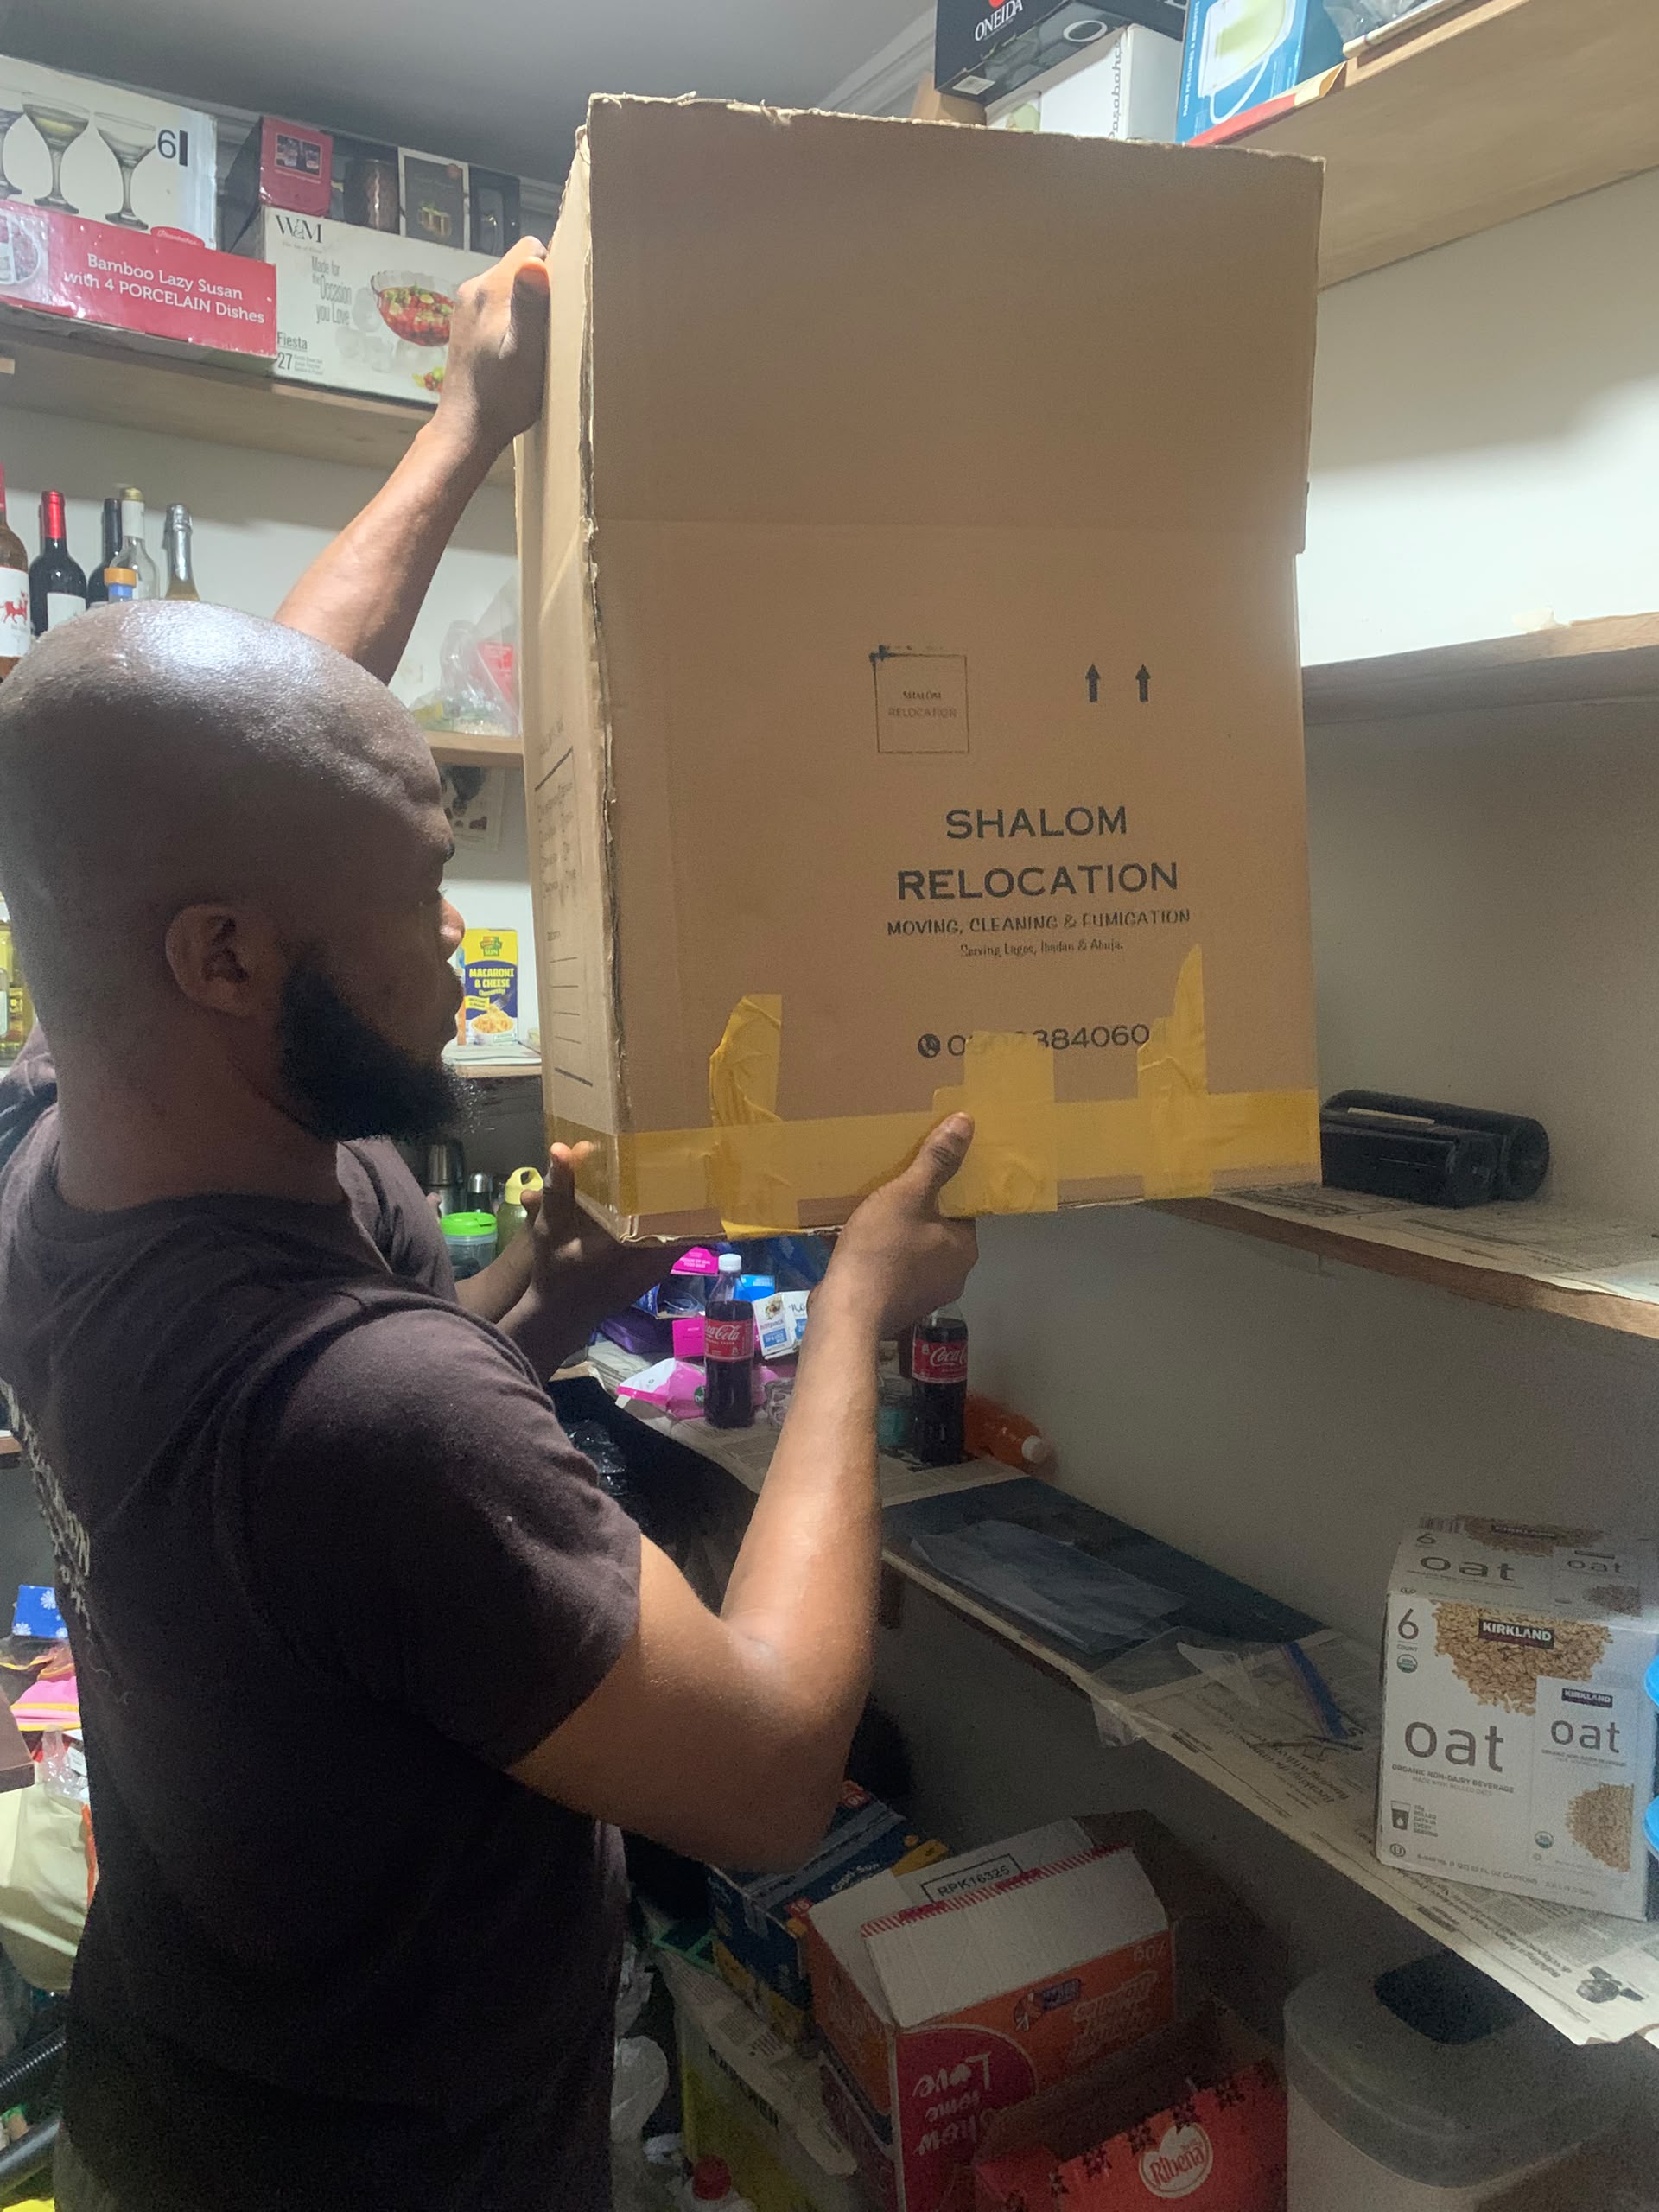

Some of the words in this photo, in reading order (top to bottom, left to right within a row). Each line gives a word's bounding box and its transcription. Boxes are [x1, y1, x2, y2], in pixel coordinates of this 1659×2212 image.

[975, 0, 1023, 41] ONEIDA
[1185, 49, 1196, 91] FEATURES
[1192, 1, 1201, 42] BENEFITS
[87, 253, 155, 281] Bamboo
[158, 270, 194, 291] Lazy
[198, 279, 243, 300] Susan
[311, 256, 330, 275] Made
[331, 260, 340, 276] for
[63, 271, 99, 289] with
[105, 278, 114, 291] 4
[118, 281, 211, 313] PORCELAIN
[215, 302, 264, 324] Dishes
[320, 275, 353, 304] Occasion
[316, 304, 331, 325] you
[332, 302, 350, 325] Love
[277, 332, 308, 350] Fiesta
[277, 352, 293, 371] 27
[945, 805, 1127, 840] SHALOM
[897, 862, 1178, 900] RELOCATION
[887, 918, 963, 936] MOVING,
[969, 915, 1058, 933] CLEANING
[1064, 914, 1077, 929] &
[1083, 909, 1191, 928] FUMIGATION
[960, 944, 1002, 958] Serving
[1077, 939, 1088, 950] &
[469, 968, 515, 978] MACARONI
[482, 979, 511, 988] CHEESE
[1416, 1533, 1437, 1545] 6
[1420, 1556, 1515, 1582] oat
[1567, 1560, 1620, 1573] oat
[1398, 1608, 1419, 1640] 6
[1482, 1621, 1553, 1642] KIRKLAND
[1397, 1643, 1419, 1652] COUNT
[1564, 1689, 1611, 1704] KIRKLAND
[1404, 1721, 1504, 1772] oat
[1551, 1720, 1621, 1754] oat
[1392, 1764, 1426, 1777] ORGANIC
[1427, 1771, 1471, 1784] NON-DAIRY
[1472, 1779, 1515, 1794] BEVERAGE
[938, 1866, 1010, 1897] RPK16325
[1149, 2146, 1205, 2186] Ribena
